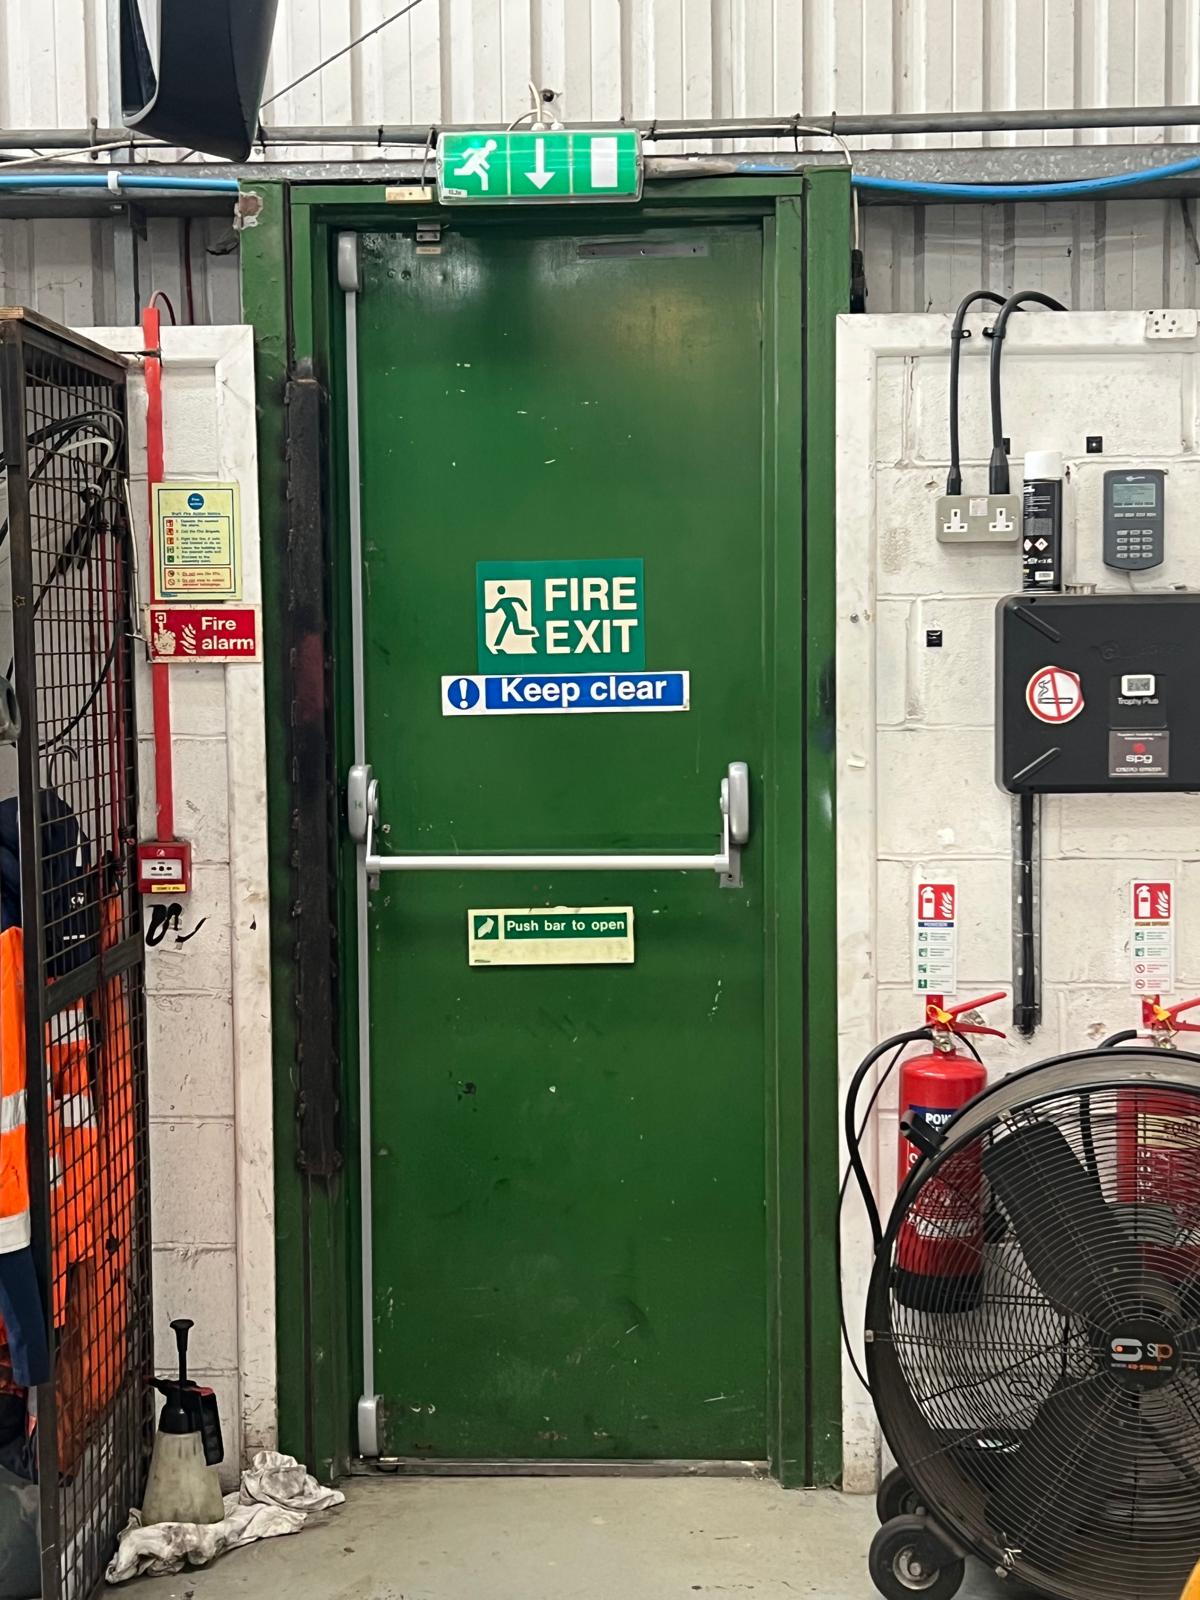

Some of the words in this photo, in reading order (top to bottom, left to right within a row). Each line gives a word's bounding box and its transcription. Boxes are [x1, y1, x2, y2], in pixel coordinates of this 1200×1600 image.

[545, 576, 638, 611] FIRE
[201, 616, 237, 631] Fire
[201, 635, 254, 650] alarm
[546, 618, 639, 654] EXIT
[501, 677, 581, 708] Keep
[590, 674, 667, 701] clear
[1117, 697, 1142, 706] Trophy
[1142, 697, 1160, 705] Plus
[1125, 754, 1153, 764] spg
[506, 920, 539, 931] Push
[544, 919, 566, 931] bar
[572, 919, 586, 931] to
[591, 920, 625, 932] open
